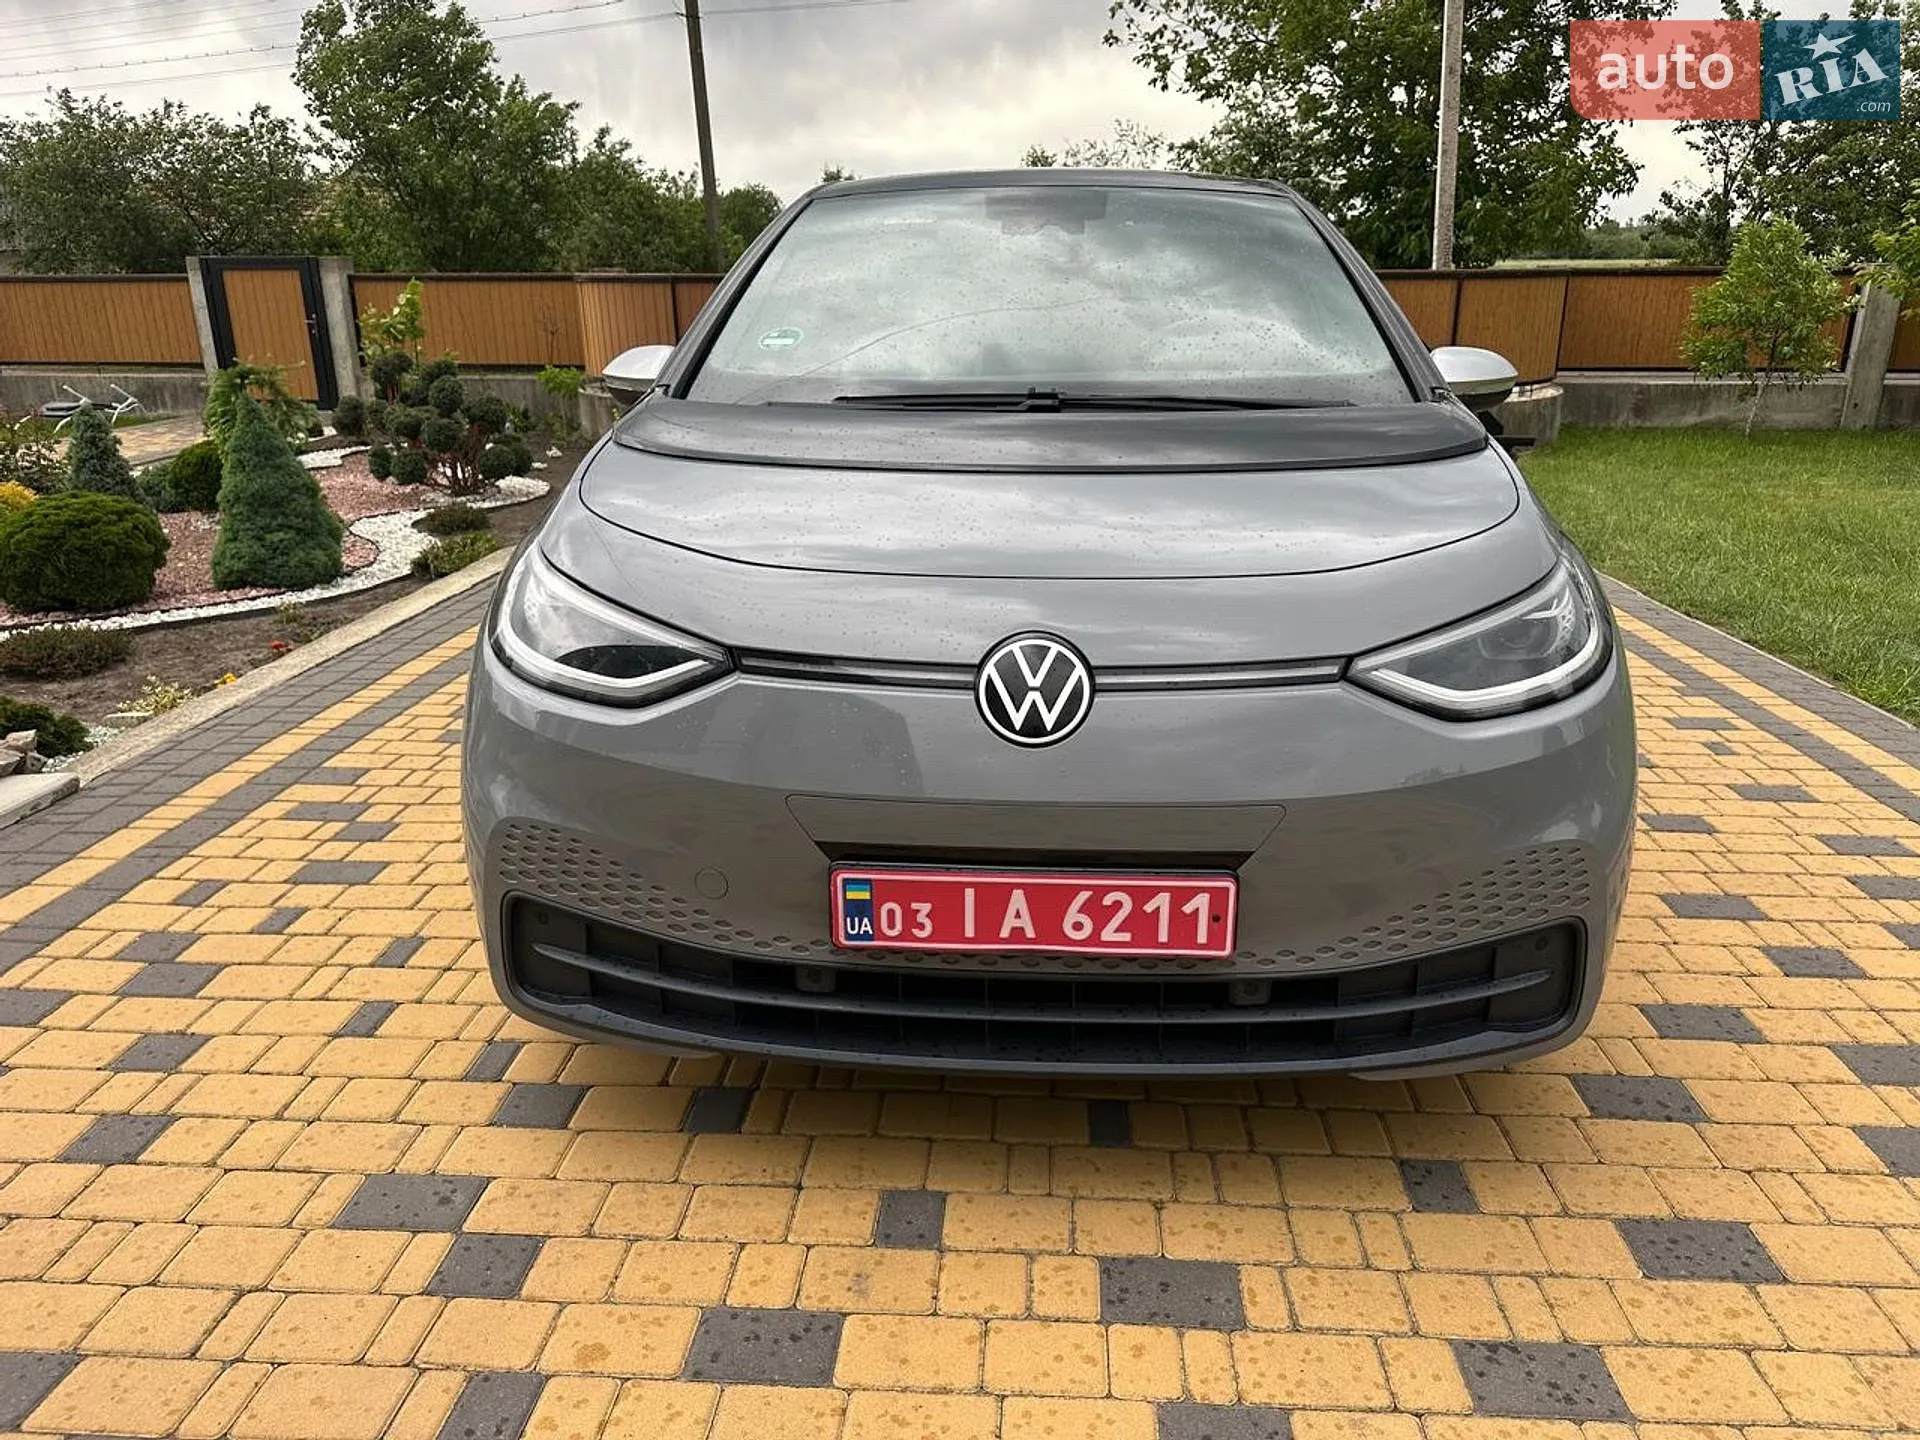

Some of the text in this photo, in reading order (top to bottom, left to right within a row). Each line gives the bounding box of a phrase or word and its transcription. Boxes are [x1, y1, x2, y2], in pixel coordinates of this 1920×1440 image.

[983, 640, 1085, 733] VW
[845, 916, 874, 936] UA
[880, 901, 934, 939] 03
[1061, 889, 1212, 945] 6211
